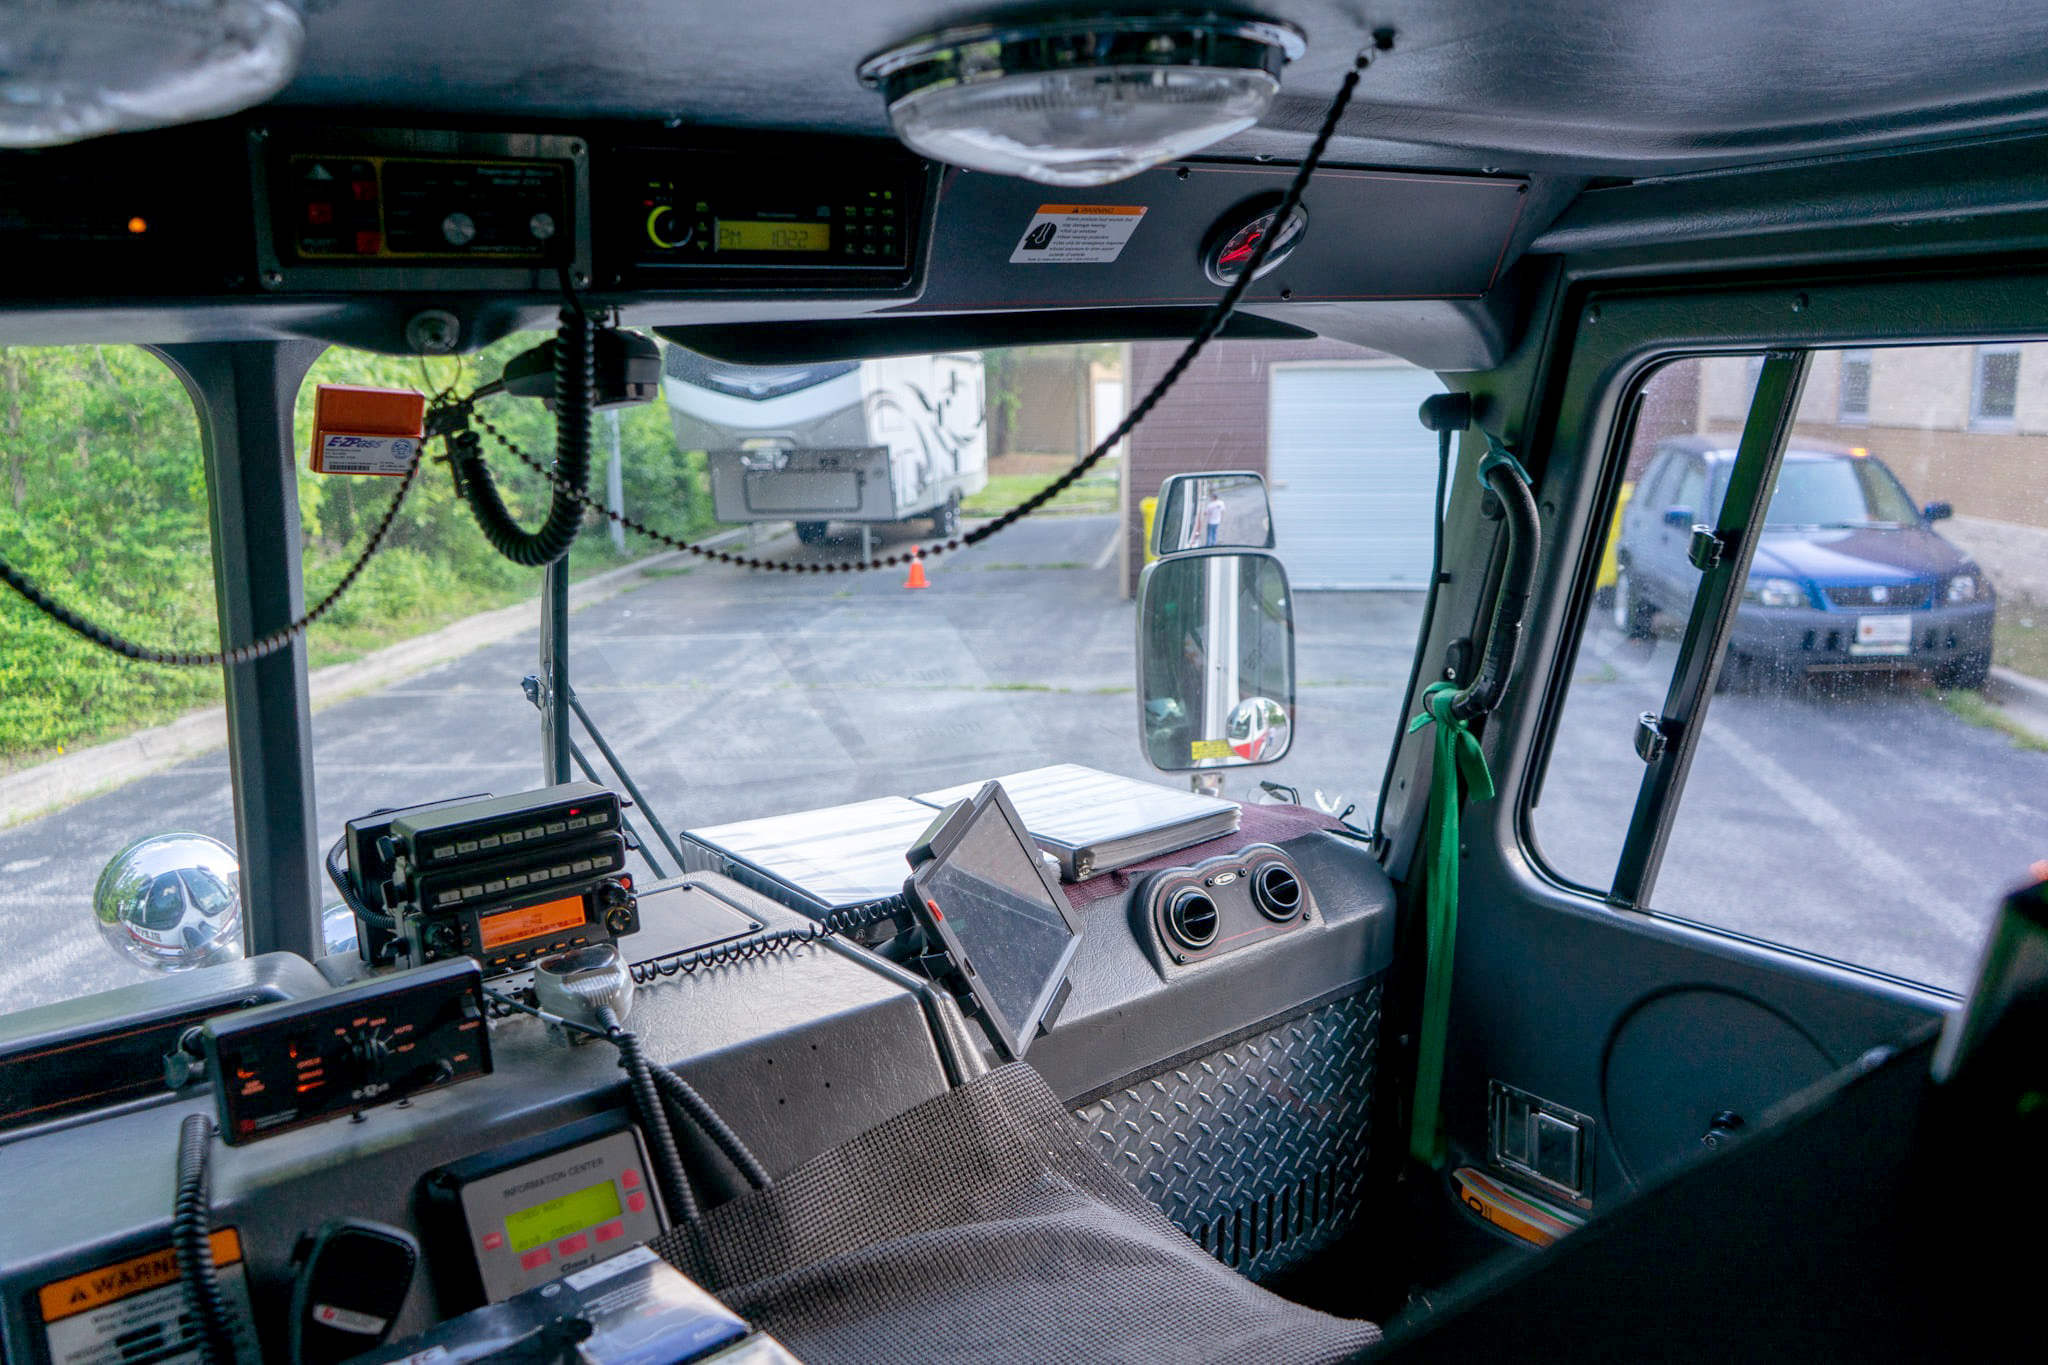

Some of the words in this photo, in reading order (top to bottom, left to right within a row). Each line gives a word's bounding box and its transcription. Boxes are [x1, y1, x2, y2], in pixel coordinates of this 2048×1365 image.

[327, 436, 382, 448] E-ZPass
[503, 1170, 568, 1199] INFORMATION
[568, 1157, 604, 1177] CENTER
